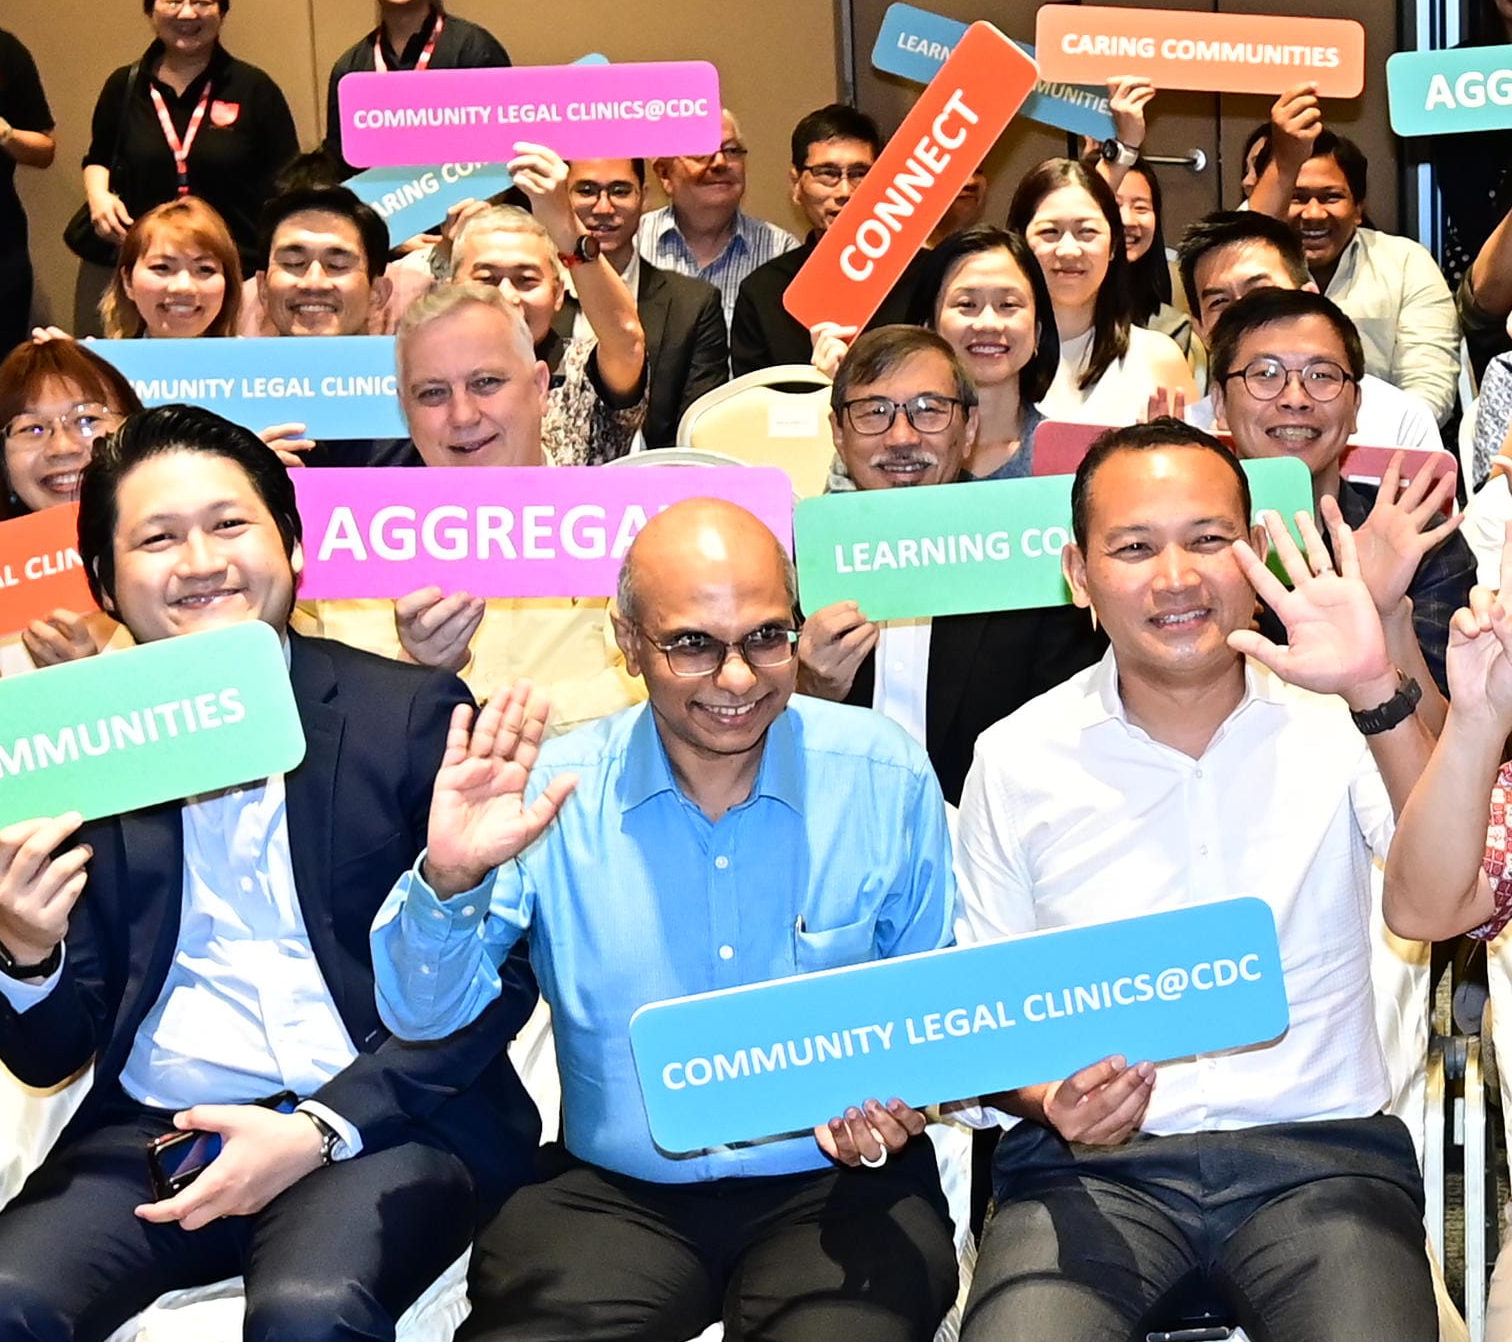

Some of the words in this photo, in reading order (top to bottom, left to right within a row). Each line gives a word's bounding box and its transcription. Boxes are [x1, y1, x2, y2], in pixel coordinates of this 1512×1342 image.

[897, 32, 954, 61] LEARN
[1061, 33, 1156, 60] CARING
[1161, 38, 1340, 68] COMMUNITIES
[354, 105, 491, 129] COMMUNITY
[498, 102, 561, 123] LEGAL
[566, 97, 708, 122] CLINICS@CDC
[838, 89, 980, 282] CONNECT
[242, 377, 315, 398] LEGAL
[321, 375, 397, 397] CLINIC
[319, 504, 660, 560] AGGREGA
[834, 536, 1009, 574] LEARNING
[662, 1021, 894, 1090] COMMUNITY
[905, 1000, 1016, 1046] LEGAL
[1023, 953, 1262, 1020] CLINICS@CDC
